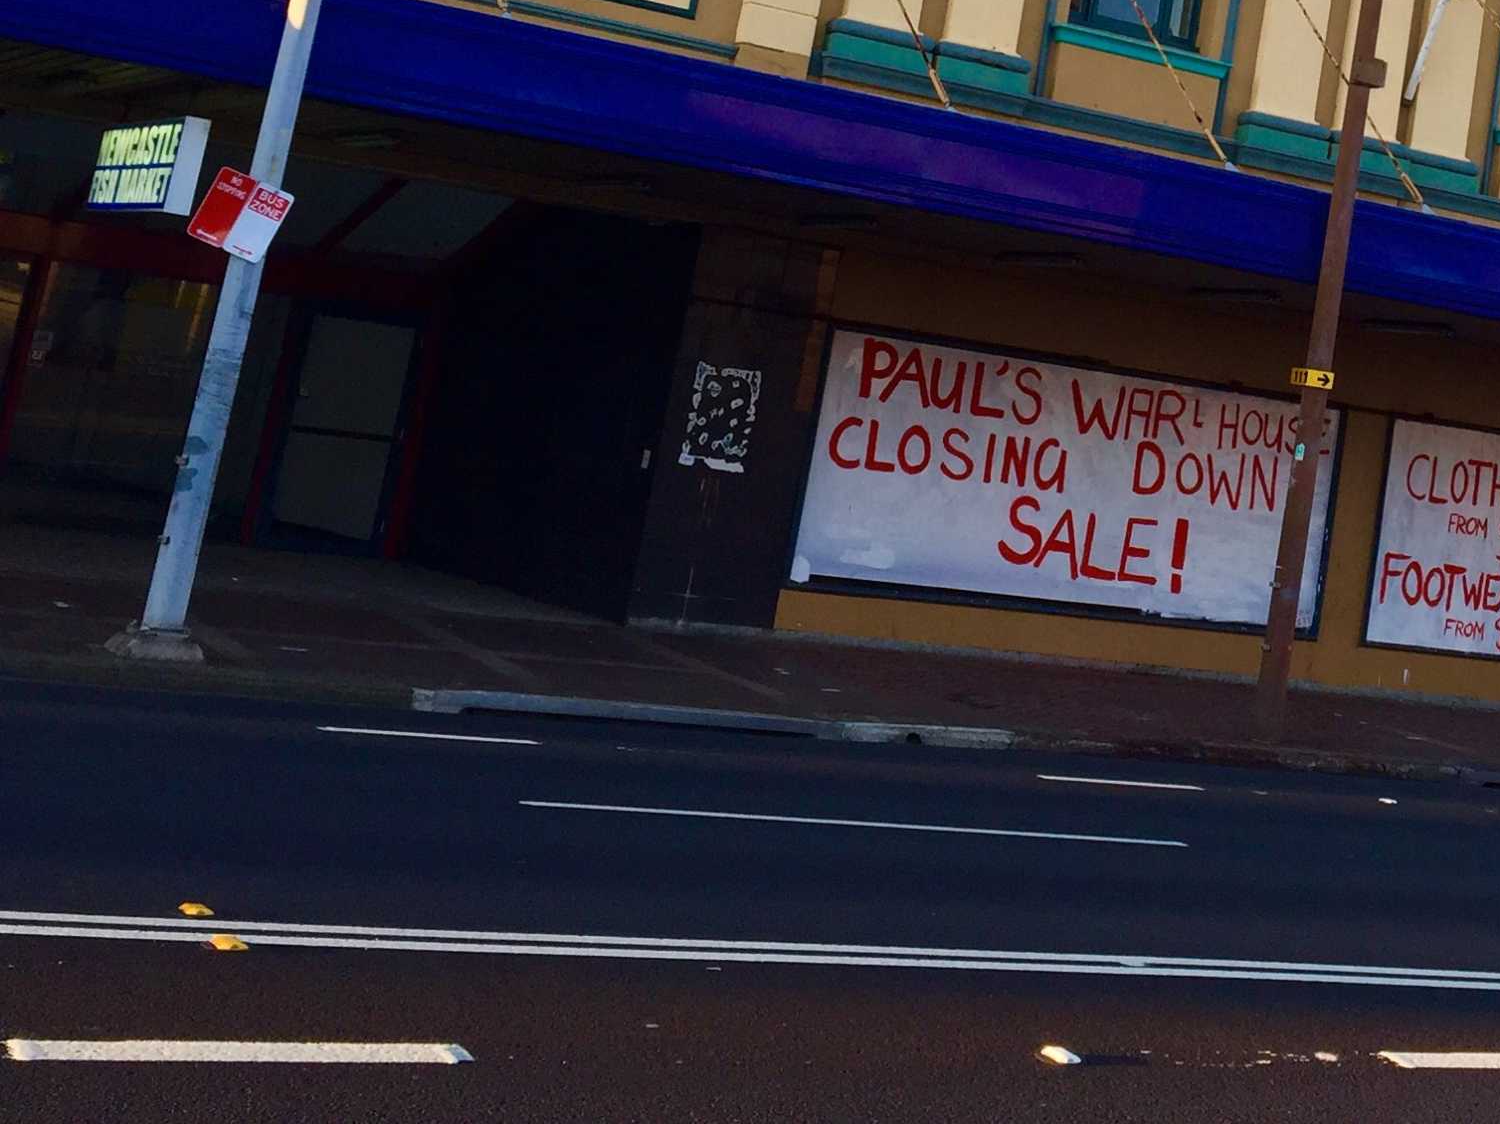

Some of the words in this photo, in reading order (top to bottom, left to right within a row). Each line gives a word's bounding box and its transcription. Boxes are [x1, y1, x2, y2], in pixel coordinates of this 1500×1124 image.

[96, 124, 183, 167] NEWCASTLE
[88, 169, 120, 204] FISH
[115, 167, 172, 204] MARKET
[258, 190, 286, 209] BUS
[250, 199, 282, 220] ZONE
[858, 337, 1042, 425] PAUL'S
[828, 416, 1067, 493] CLOSING
[1132, 440, 1278, 512] DOWN
[998, 495, 1189, 594] SALE!
[1447, 512, 1488, 540] FROM
[1443, 618, 1485, 642] FROM
